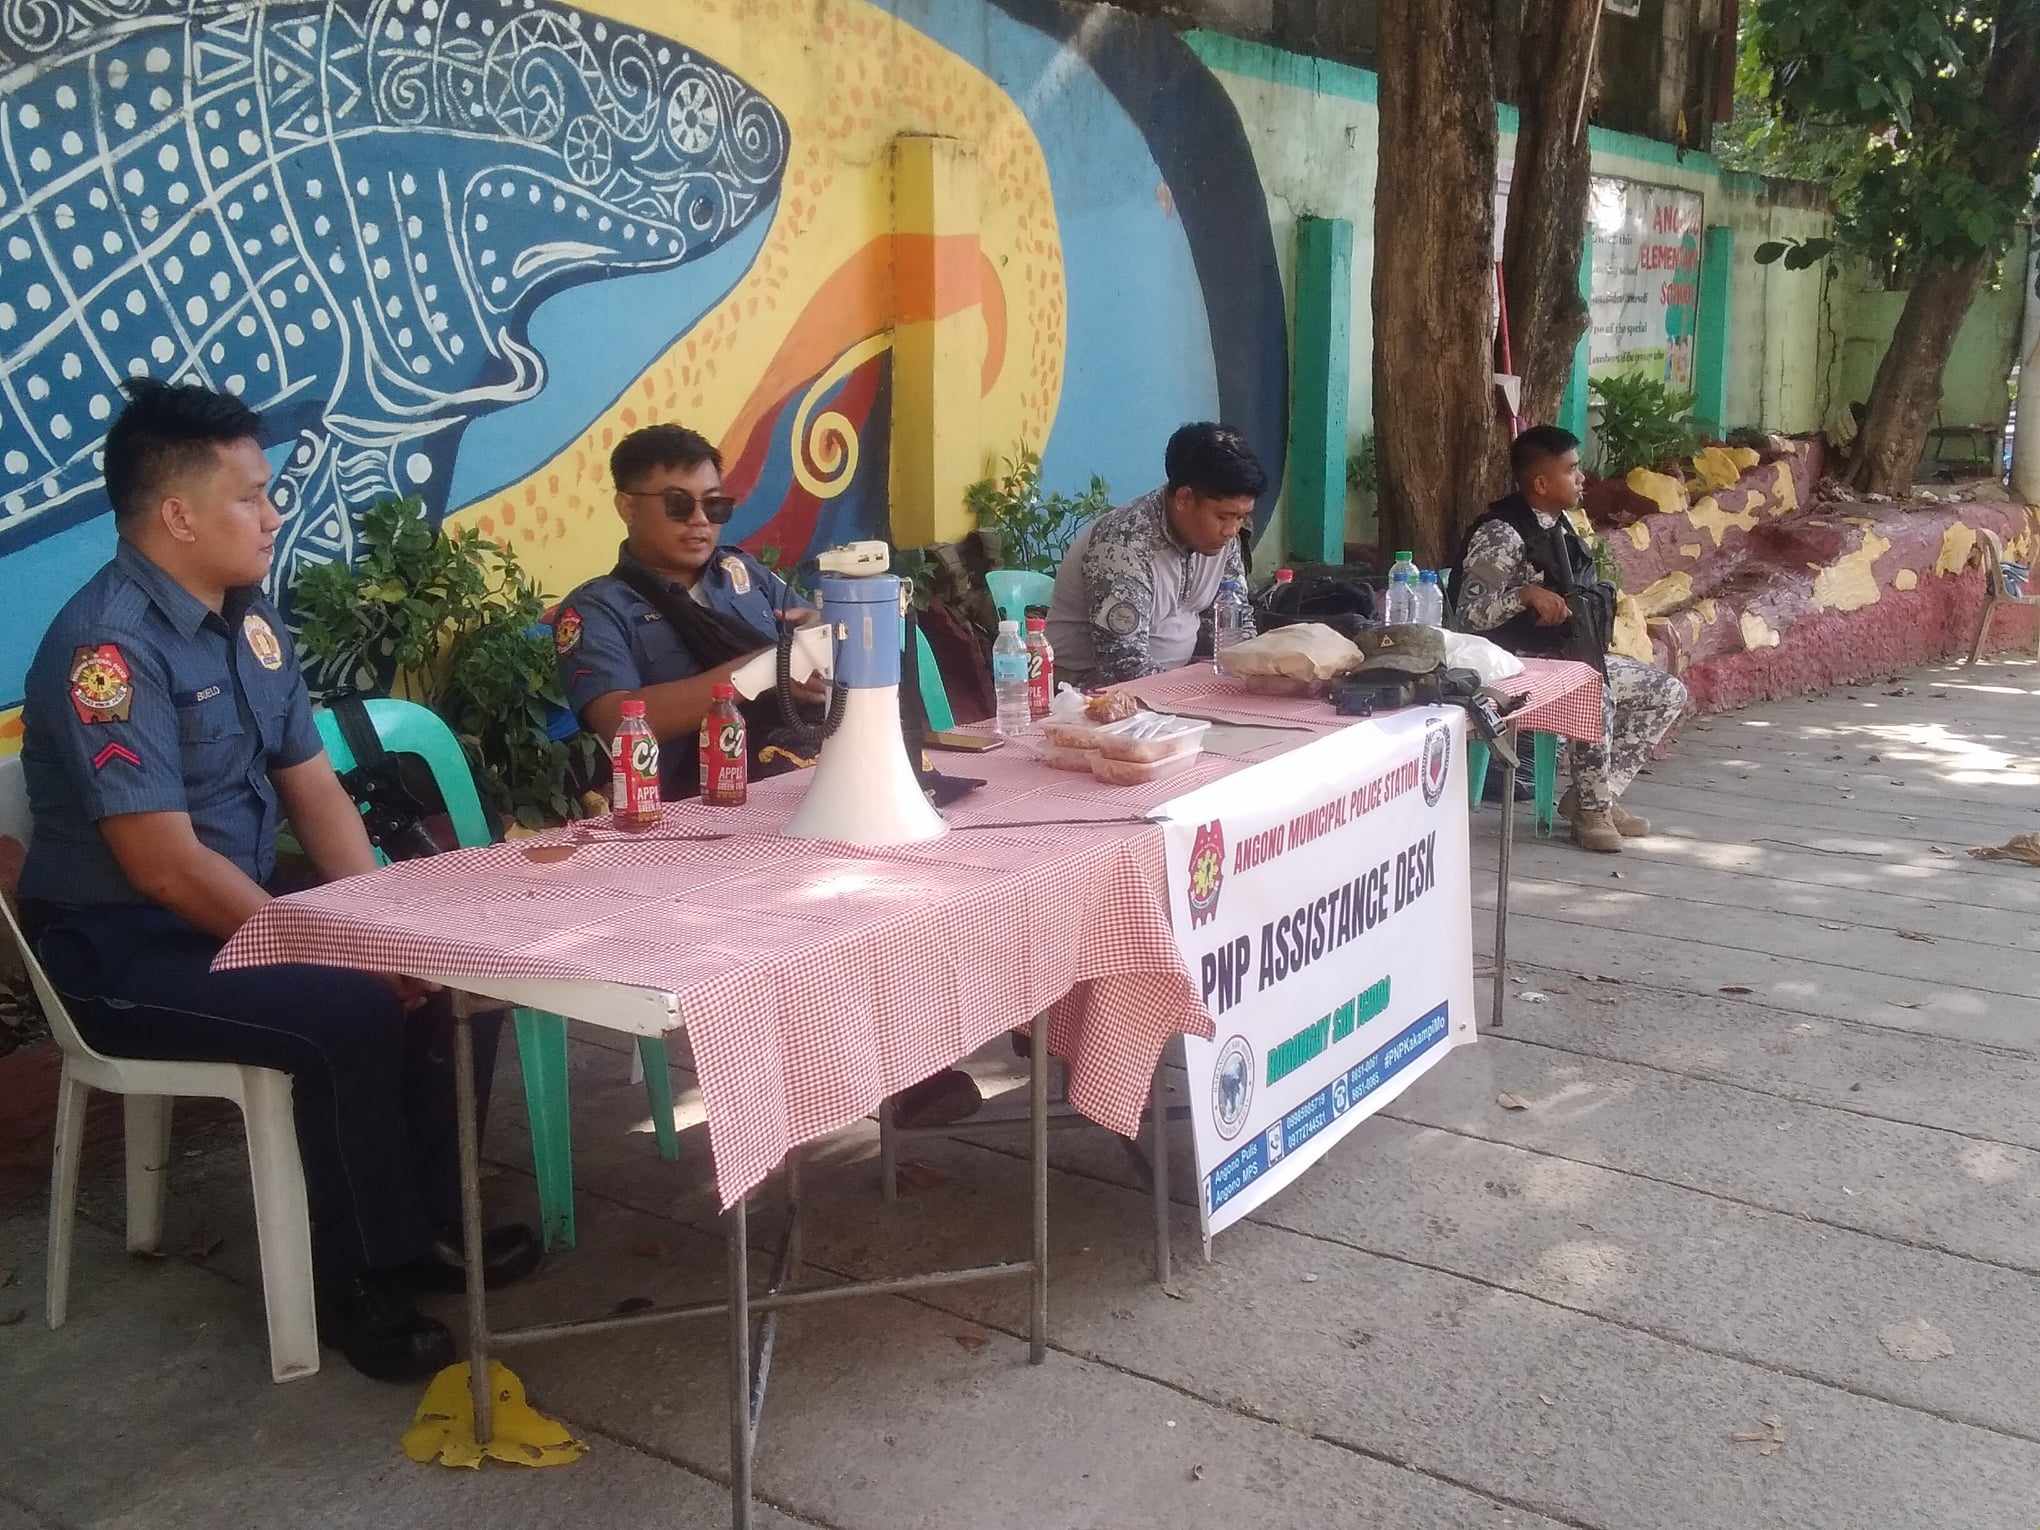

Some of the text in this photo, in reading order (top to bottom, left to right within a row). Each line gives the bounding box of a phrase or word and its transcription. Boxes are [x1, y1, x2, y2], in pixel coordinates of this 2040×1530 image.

[719, 766, 744, 780] APPLE
[1233, 824, 1286, 876] ANGONO
[1287, 795, 1347, 852] MUNICIPAL
[1350, 776, 1383, 822] POLICE
[1383, 757, 1420, 804] STATION
[1201, 935, 1251, 1016] PNP
[1258, 859, 1390, 993] ASSISTANCE
[1393, 830, 1437, 914] DESK
[1384, 1016, 1446, 1069] #PNPKakampiMo
[1215, 1159, 1240, 1185] Angono
[1215, 1162, 1259, 1204] Angono MPS
